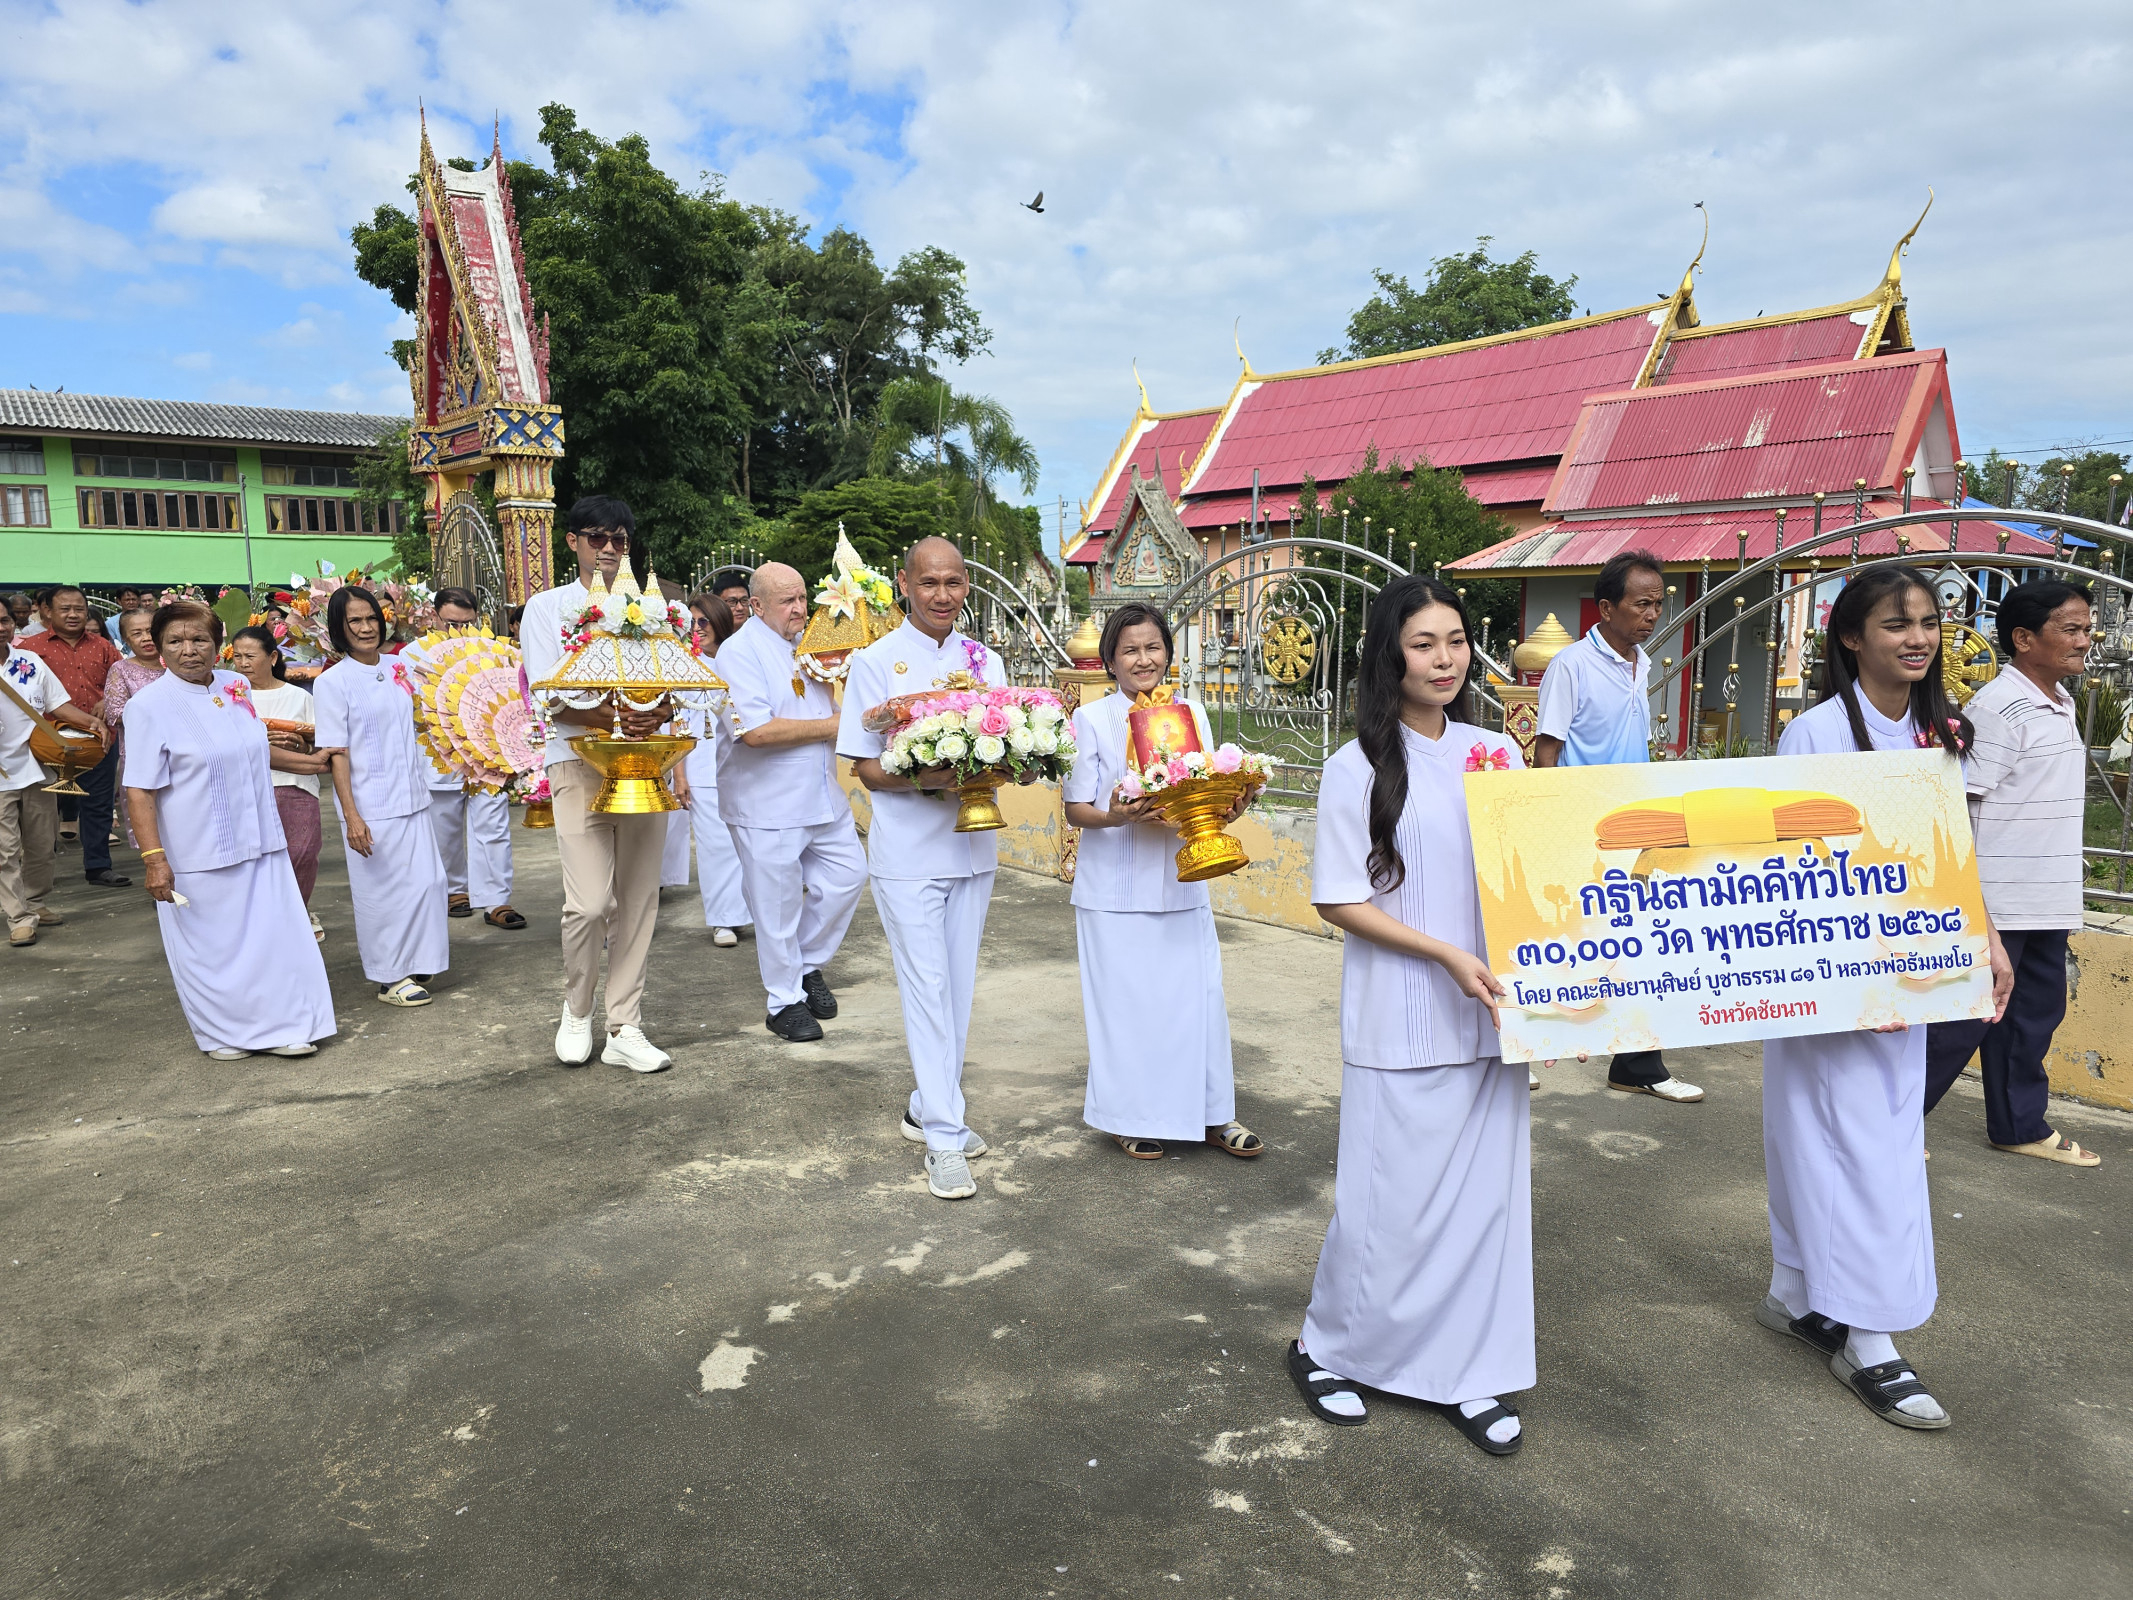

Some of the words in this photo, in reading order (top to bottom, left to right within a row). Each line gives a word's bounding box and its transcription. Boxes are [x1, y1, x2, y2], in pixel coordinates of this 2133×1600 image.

[1579, 845, 1907, 928] กฐินสามัคคีทั่วไทย
[1517, 936, 1643, 969] ๓๐,๐๐๐
[1650, 918, 1695, 956] วัด
[1700, 908, 1872, 965] พุทธศักราช
[1877, 907, 1962, 937] ๒๕๖๘
[1513, 981, 1551, 1006] โดย
[1556, 967, 1701, 1002] คณะศิษยานุศิษย์
[1705, 966, 1787, 997] บูชาธรรม
[1790, 967, 1815, 983] ๘๑
[1816, 957, 1833, 980] ปี
[1835, 944, 1973, 979] หลวงพ่อธัมมชโย
[1699, 998, 1818, 1026] จังหวัดชัยนาท
